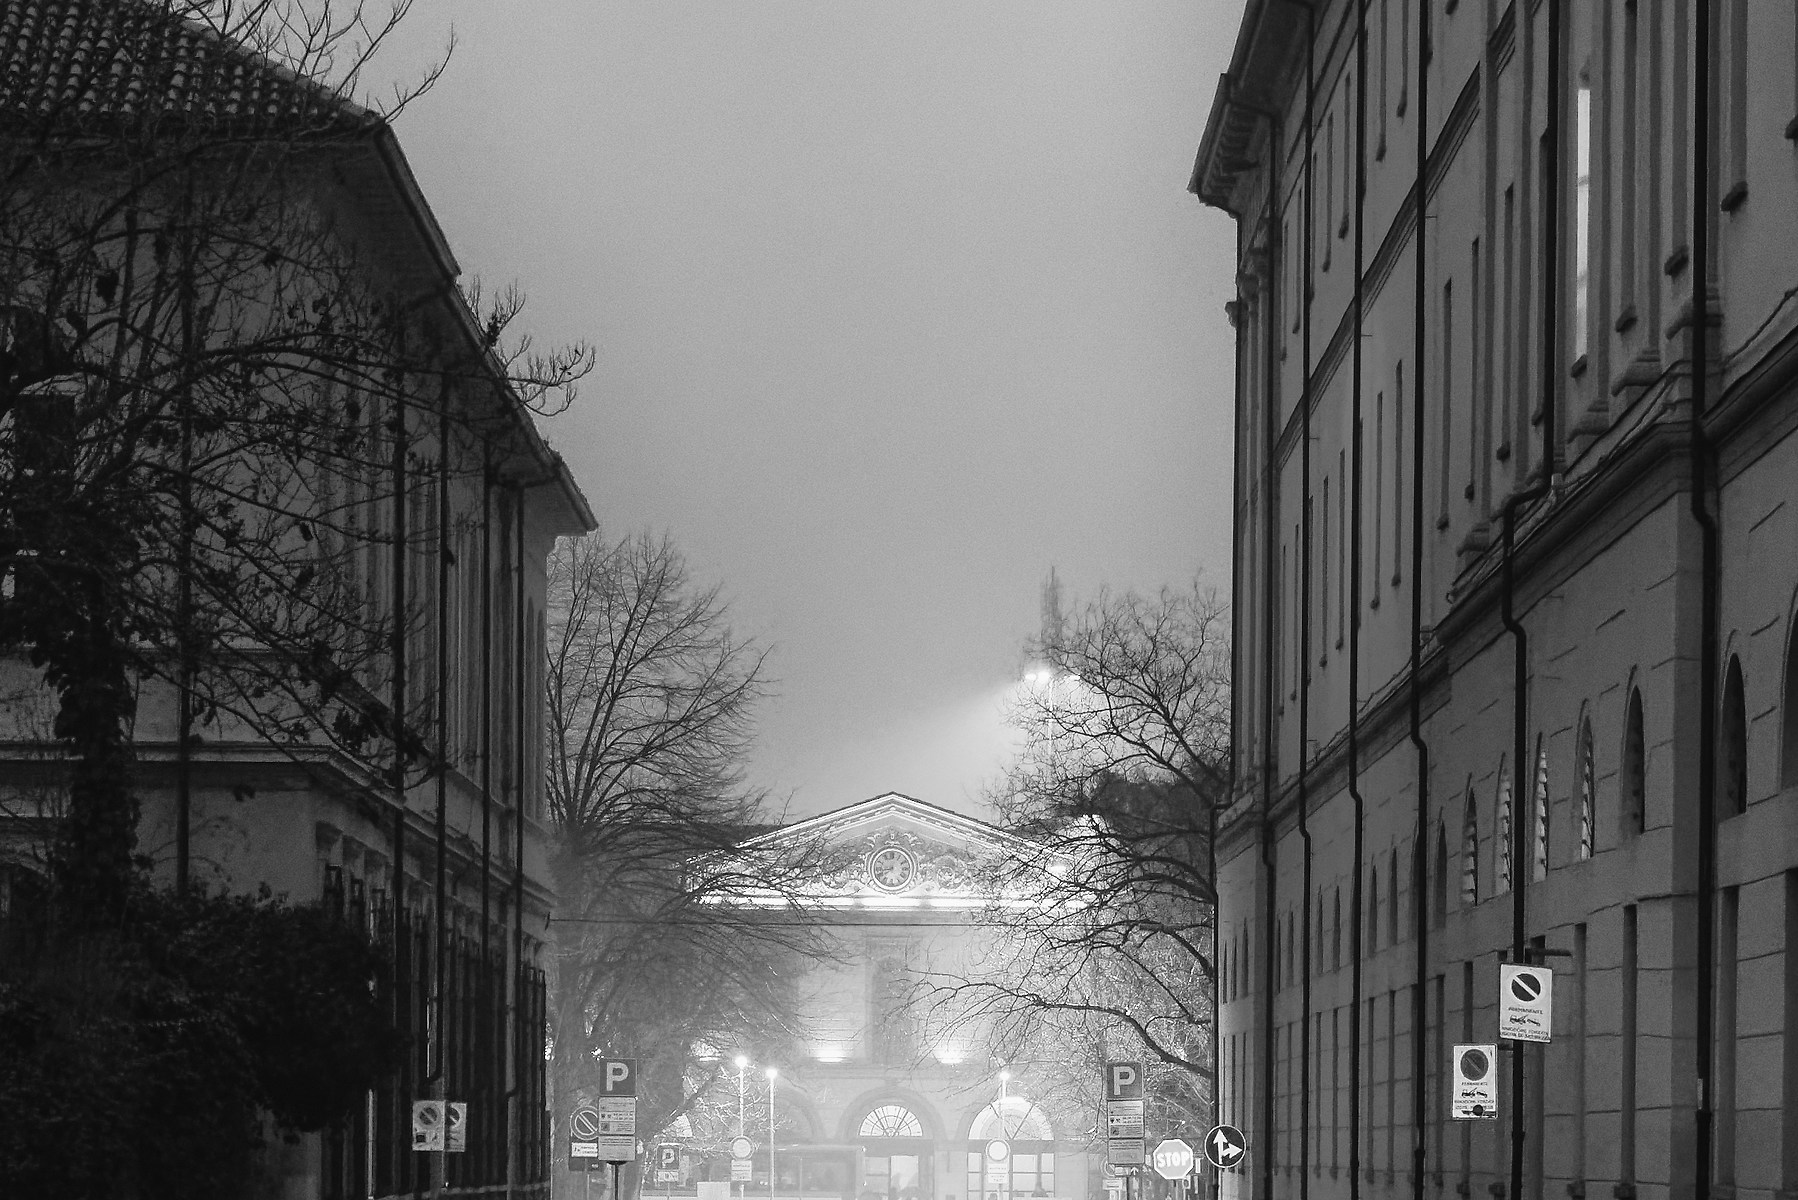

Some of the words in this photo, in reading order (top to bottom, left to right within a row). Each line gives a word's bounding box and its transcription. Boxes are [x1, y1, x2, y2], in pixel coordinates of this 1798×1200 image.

[606, 1062, 629, 1092] P
[1113, 1066, 1136, 1095] P
[661, 1148, 675, 1169] P
[1155, 1151, 1190, 1168] STOP
